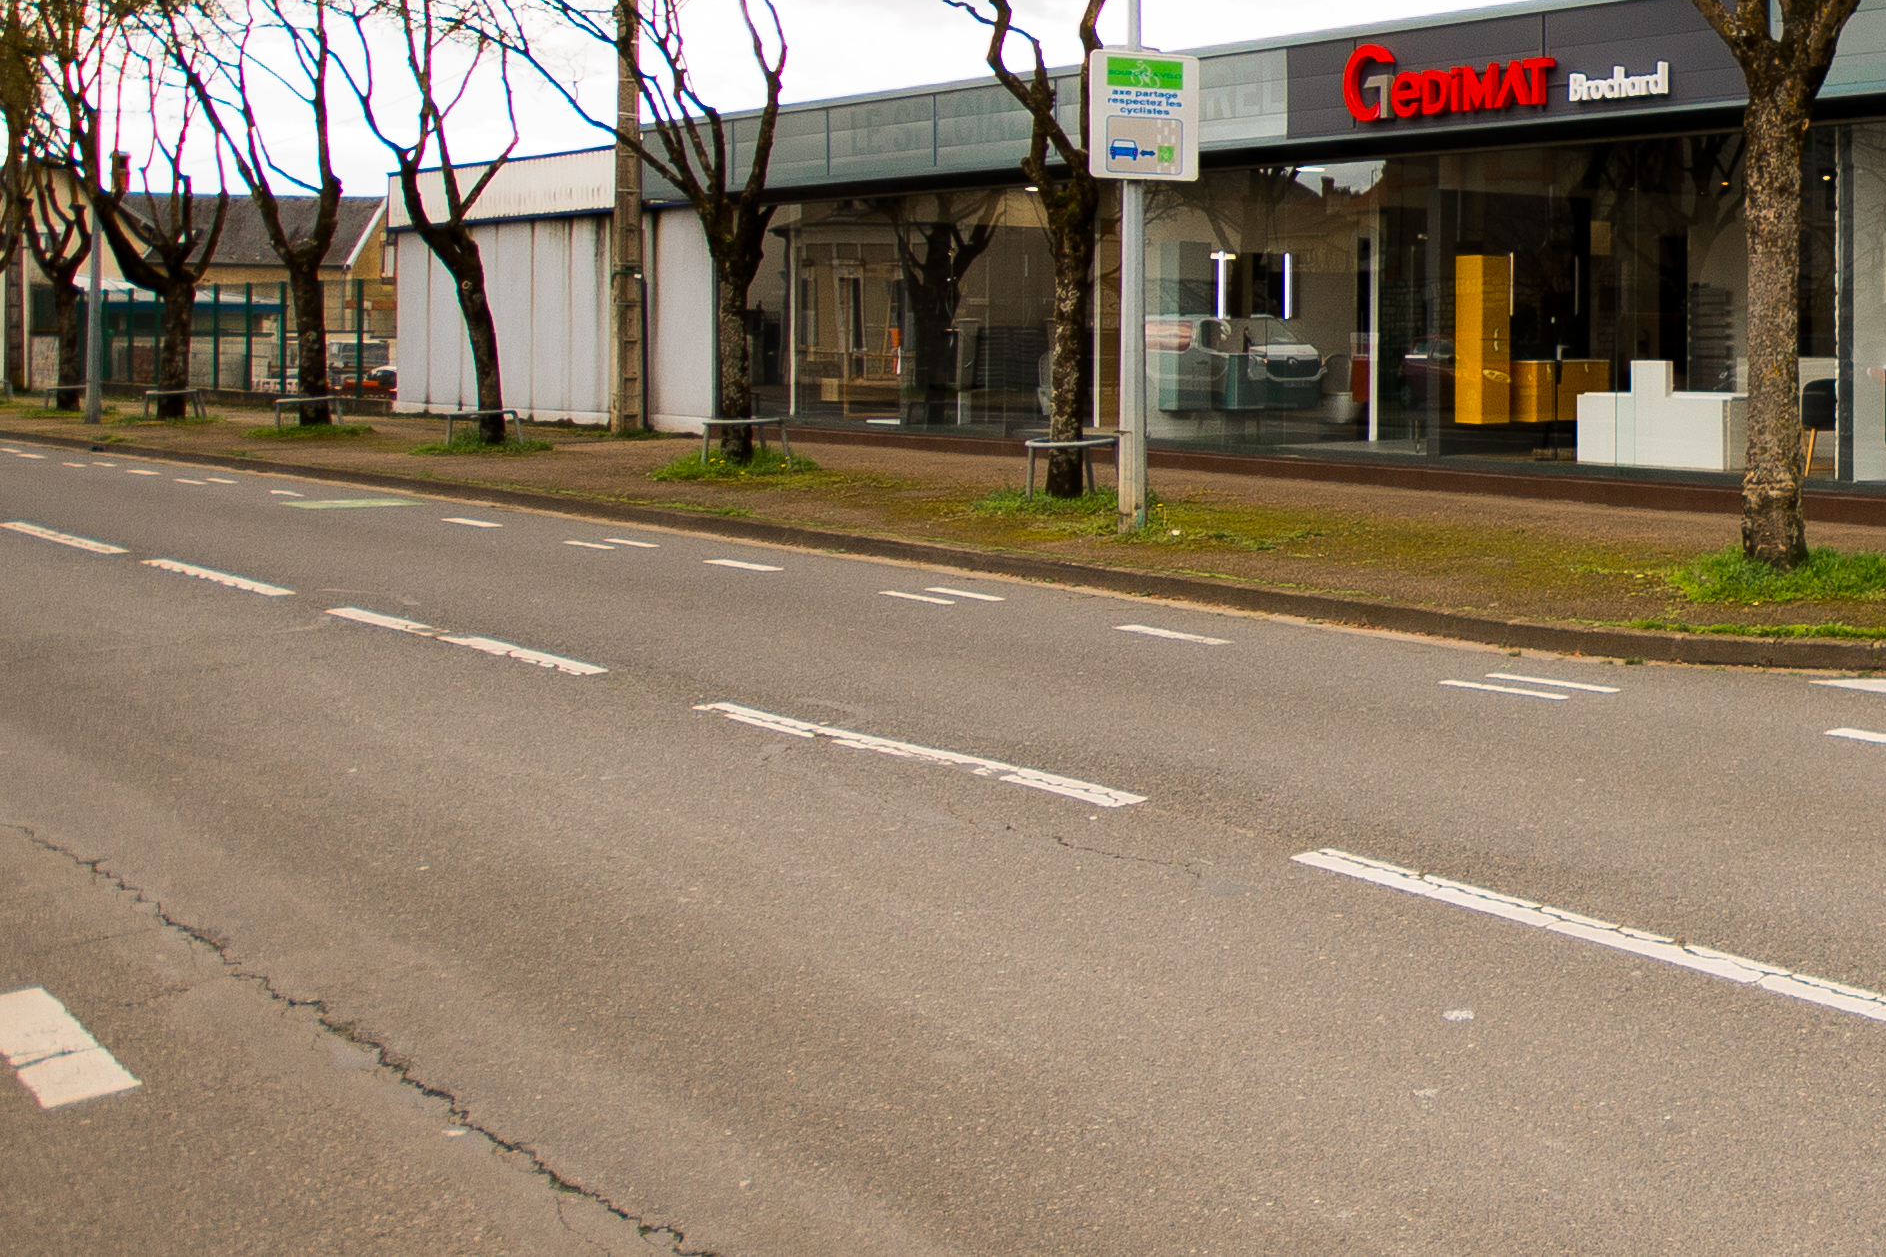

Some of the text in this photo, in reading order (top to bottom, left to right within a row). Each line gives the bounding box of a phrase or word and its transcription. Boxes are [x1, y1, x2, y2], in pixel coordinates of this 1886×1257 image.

[1568, 61, 1670, 103] Brochard
[1108, 97, 1182, 107] respectez les
[1120, 106, 1170, 115] cyclistes
